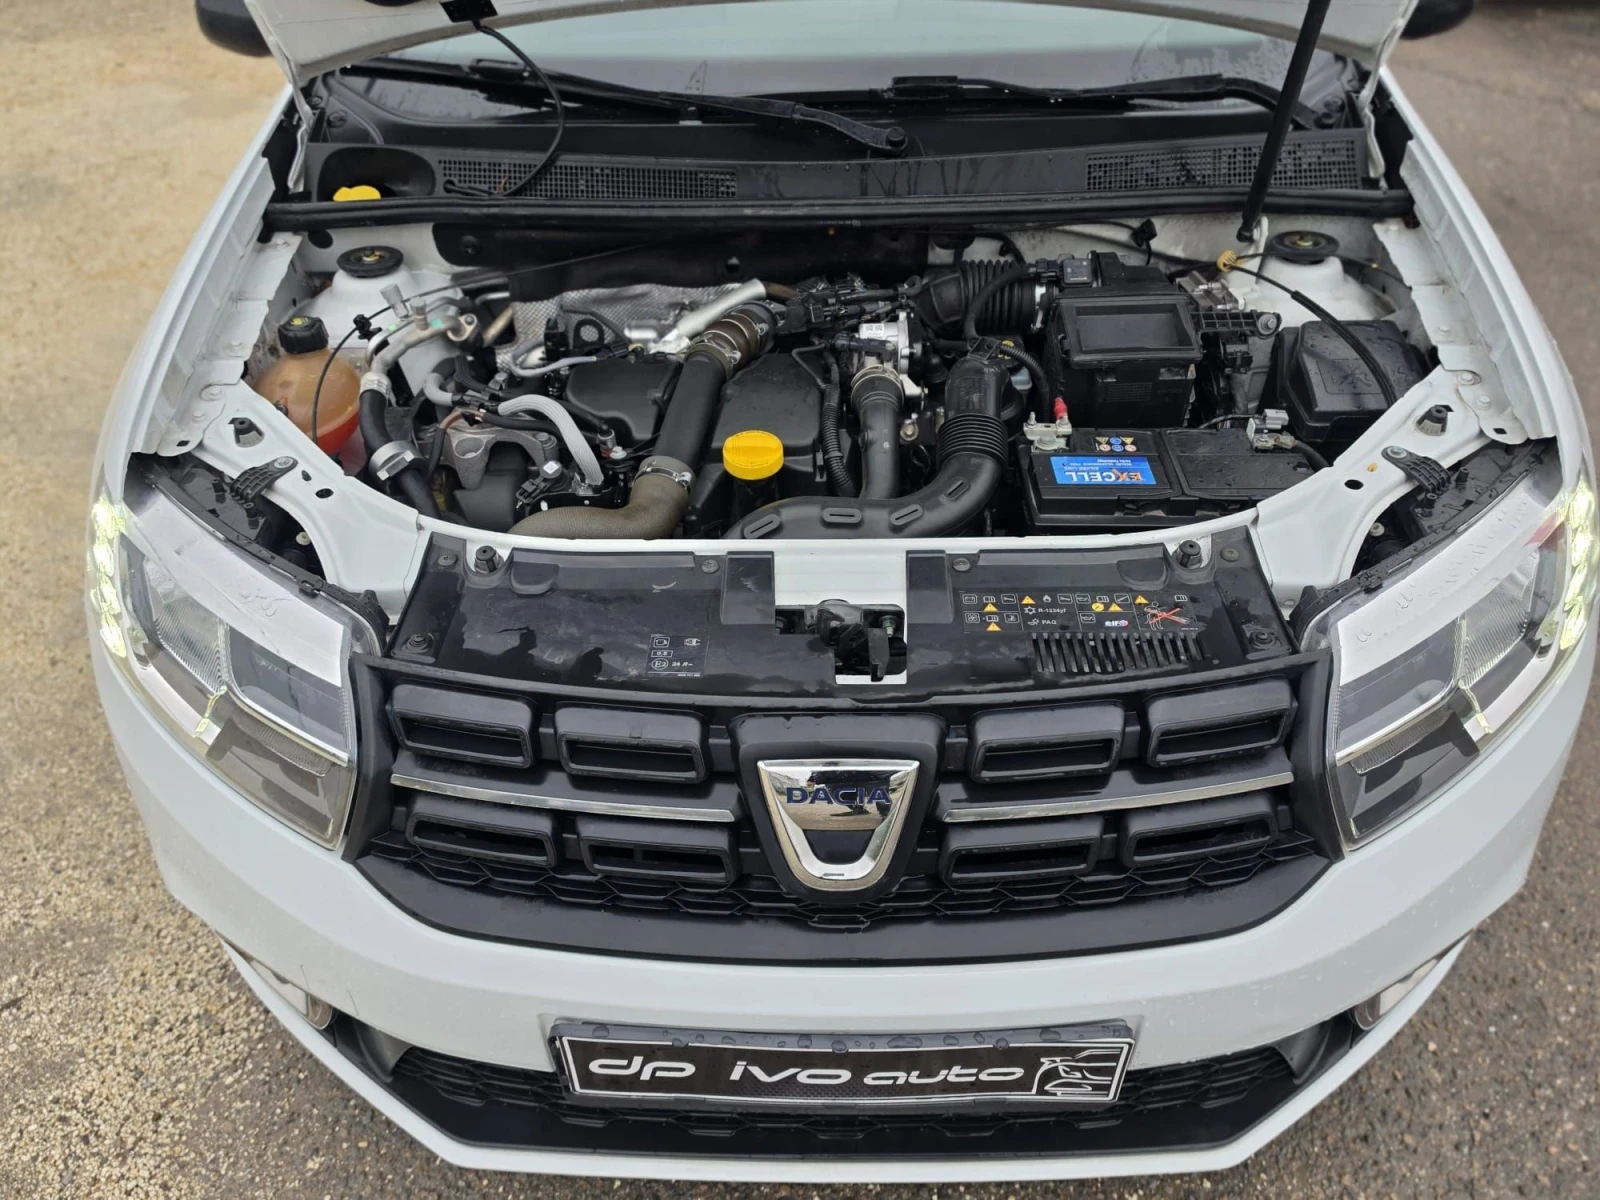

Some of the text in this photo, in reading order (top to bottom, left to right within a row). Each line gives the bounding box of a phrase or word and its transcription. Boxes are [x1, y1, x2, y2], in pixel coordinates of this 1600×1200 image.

[1064, 468, 1144, 482] EXCELL
[786, 787, 892, 805] DACIA
[588, 1056, 1025, 1085] dp ivo auto
